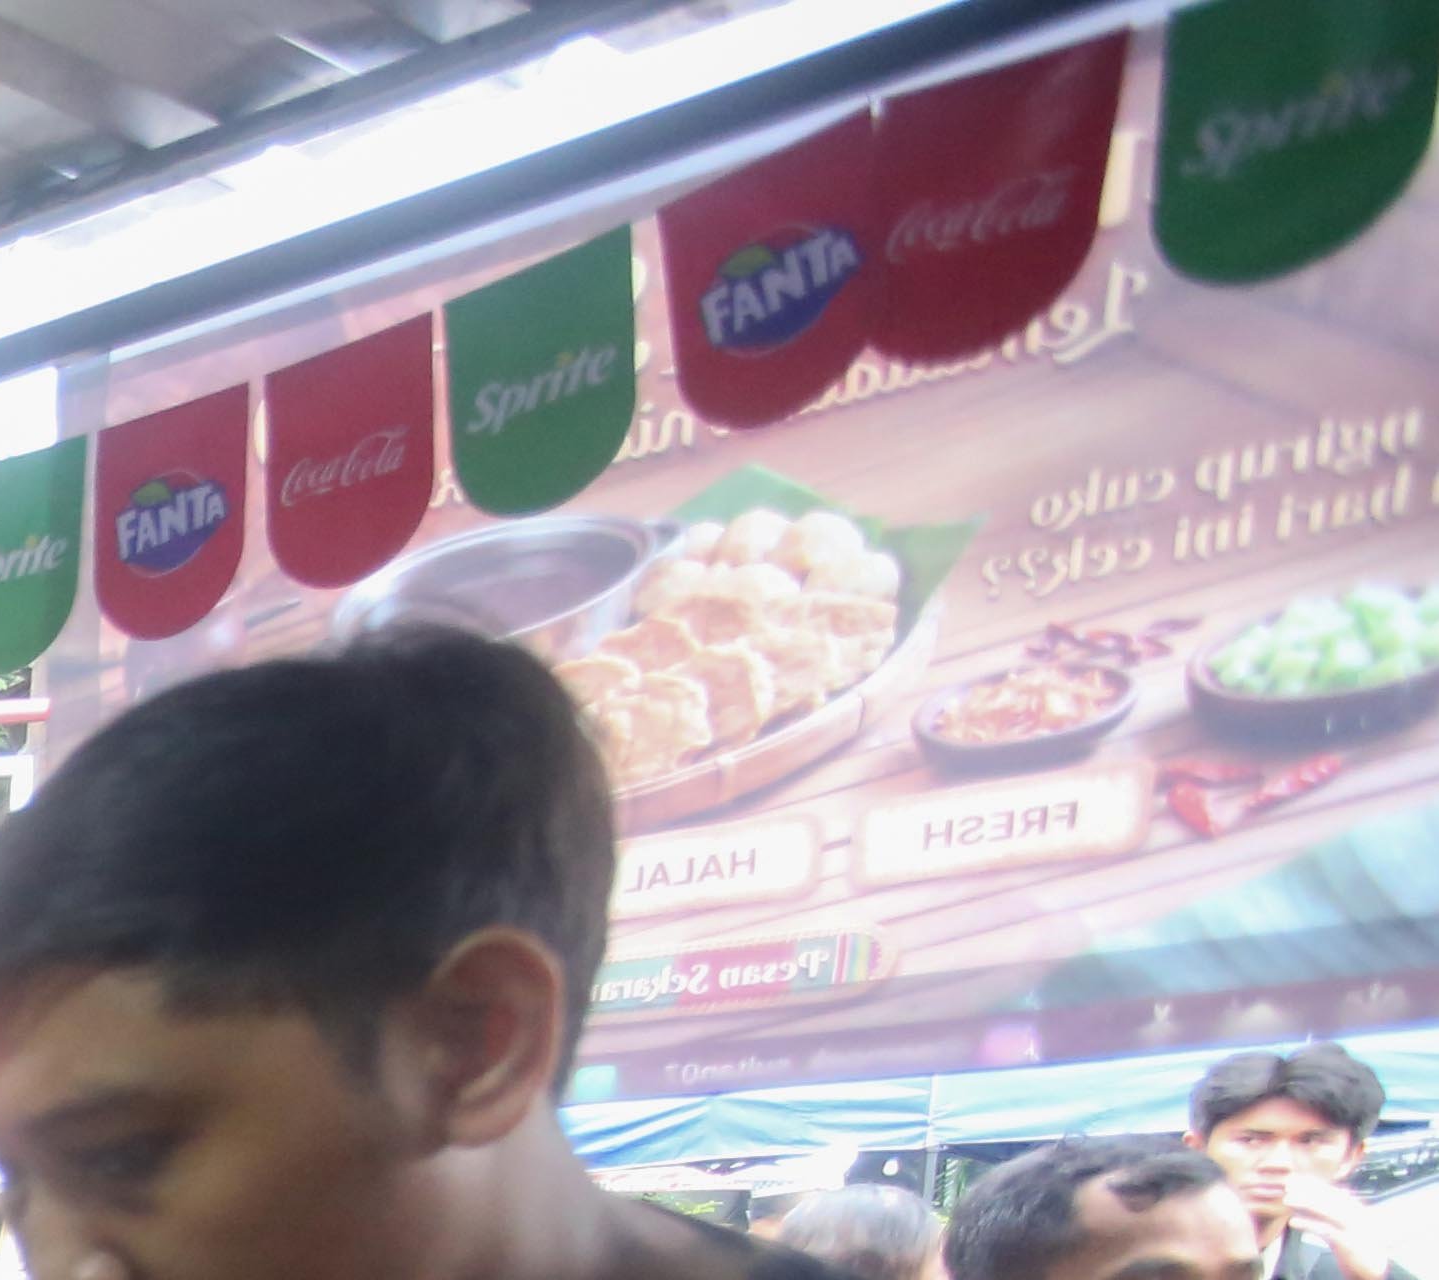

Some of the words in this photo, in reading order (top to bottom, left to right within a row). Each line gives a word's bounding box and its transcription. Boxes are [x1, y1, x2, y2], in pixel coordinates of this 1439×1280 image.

[700, 226, 859, 347] FANTA
[466, 345, 616, 436] Sprite
[116, 484, 227, 562] FANTA
